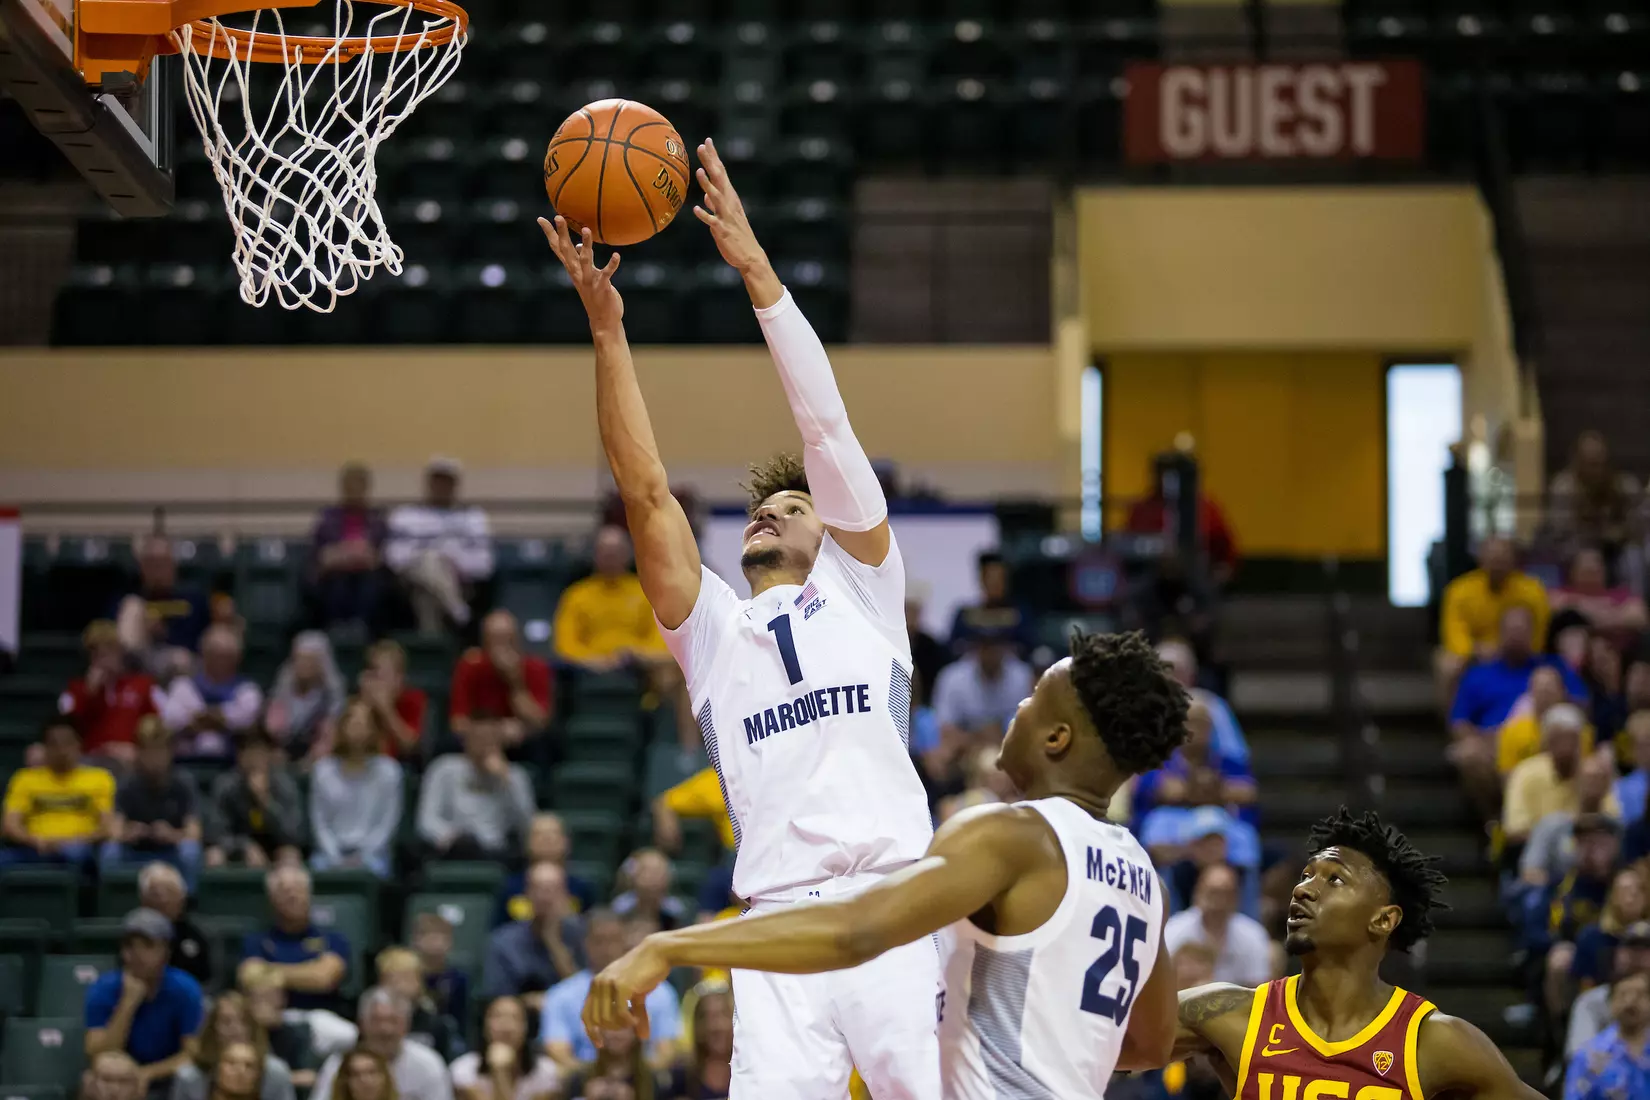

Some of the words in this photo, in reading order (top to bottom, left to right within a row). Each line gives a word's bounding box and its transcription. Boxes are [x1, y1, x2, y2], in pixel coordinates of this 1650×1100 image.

[1158, 64, 1387, 157] GUEST
[767, 613, 804, 686] 1
[743, 683, 871, 745] MARQUETTE
[1079, 904, 1148, 1028] 25
[1268, 1023, 1286, 1045] C
